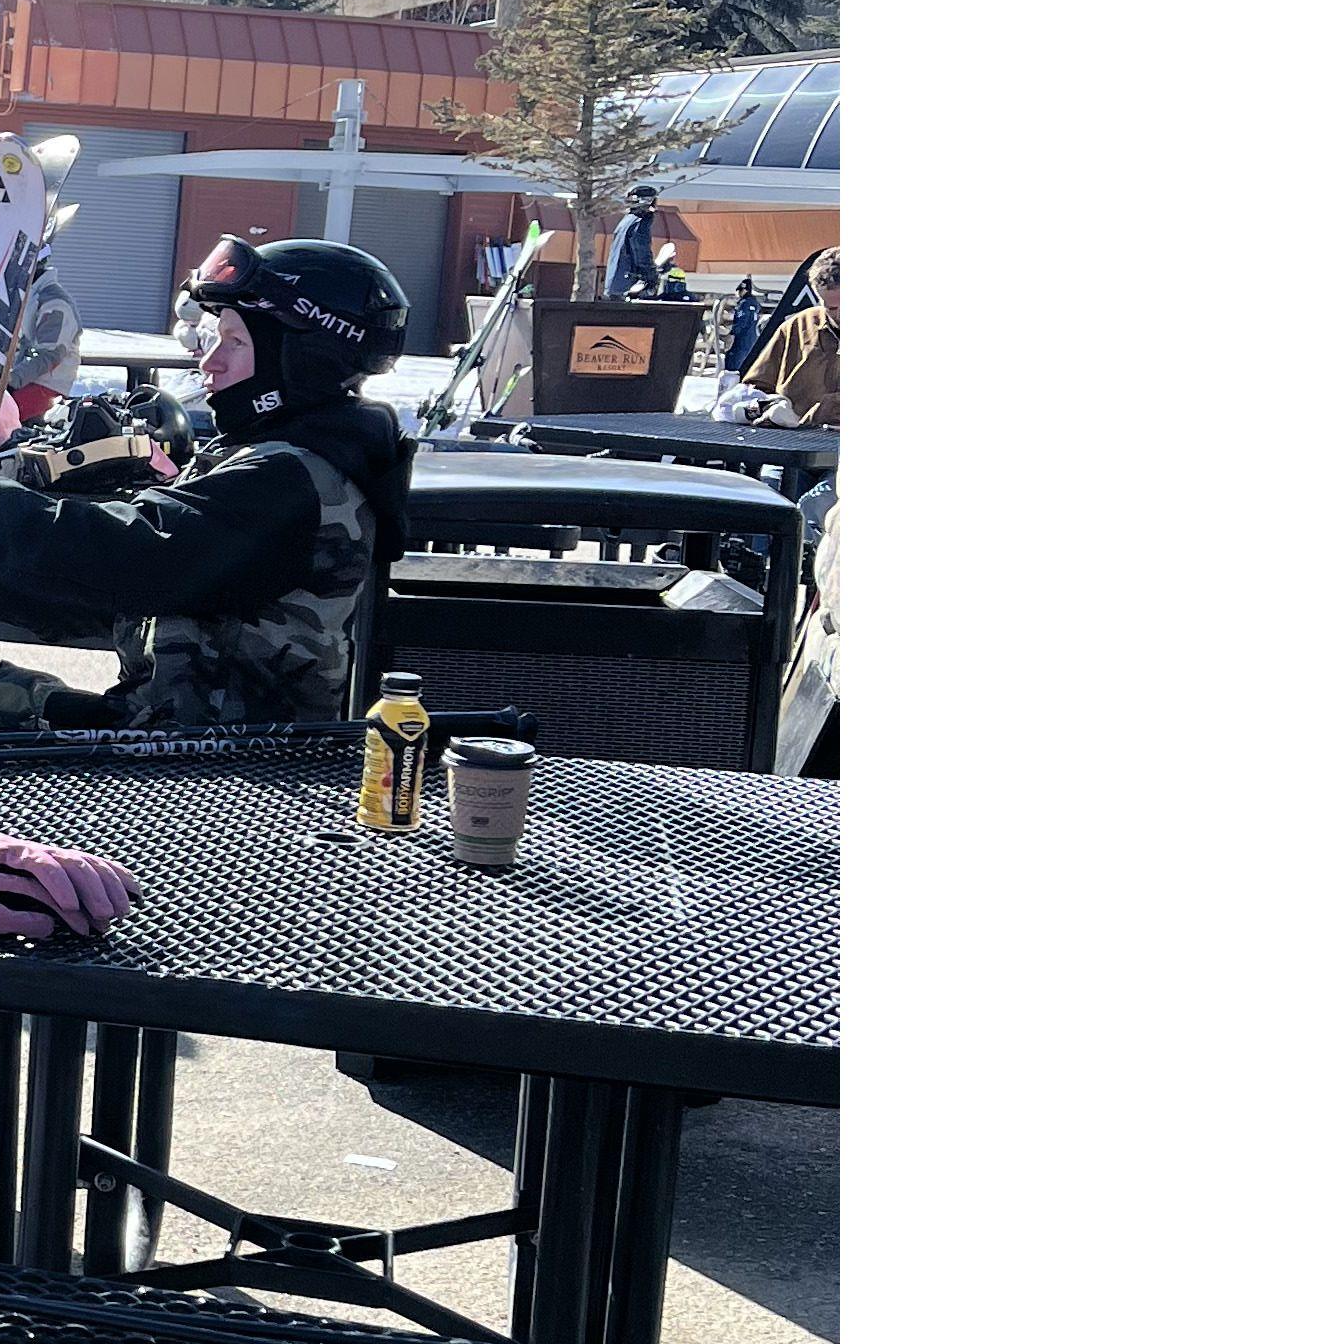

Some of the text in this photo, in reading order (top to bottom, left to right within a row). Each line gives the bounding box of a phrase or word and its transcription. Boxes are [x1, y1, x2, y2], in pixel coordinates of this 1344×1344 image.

[293, 297, 365, 343] SMITH
[576, 352, 646, 365] BEAVER RUN
[397, 745, 416, 816] BODYARMOR
